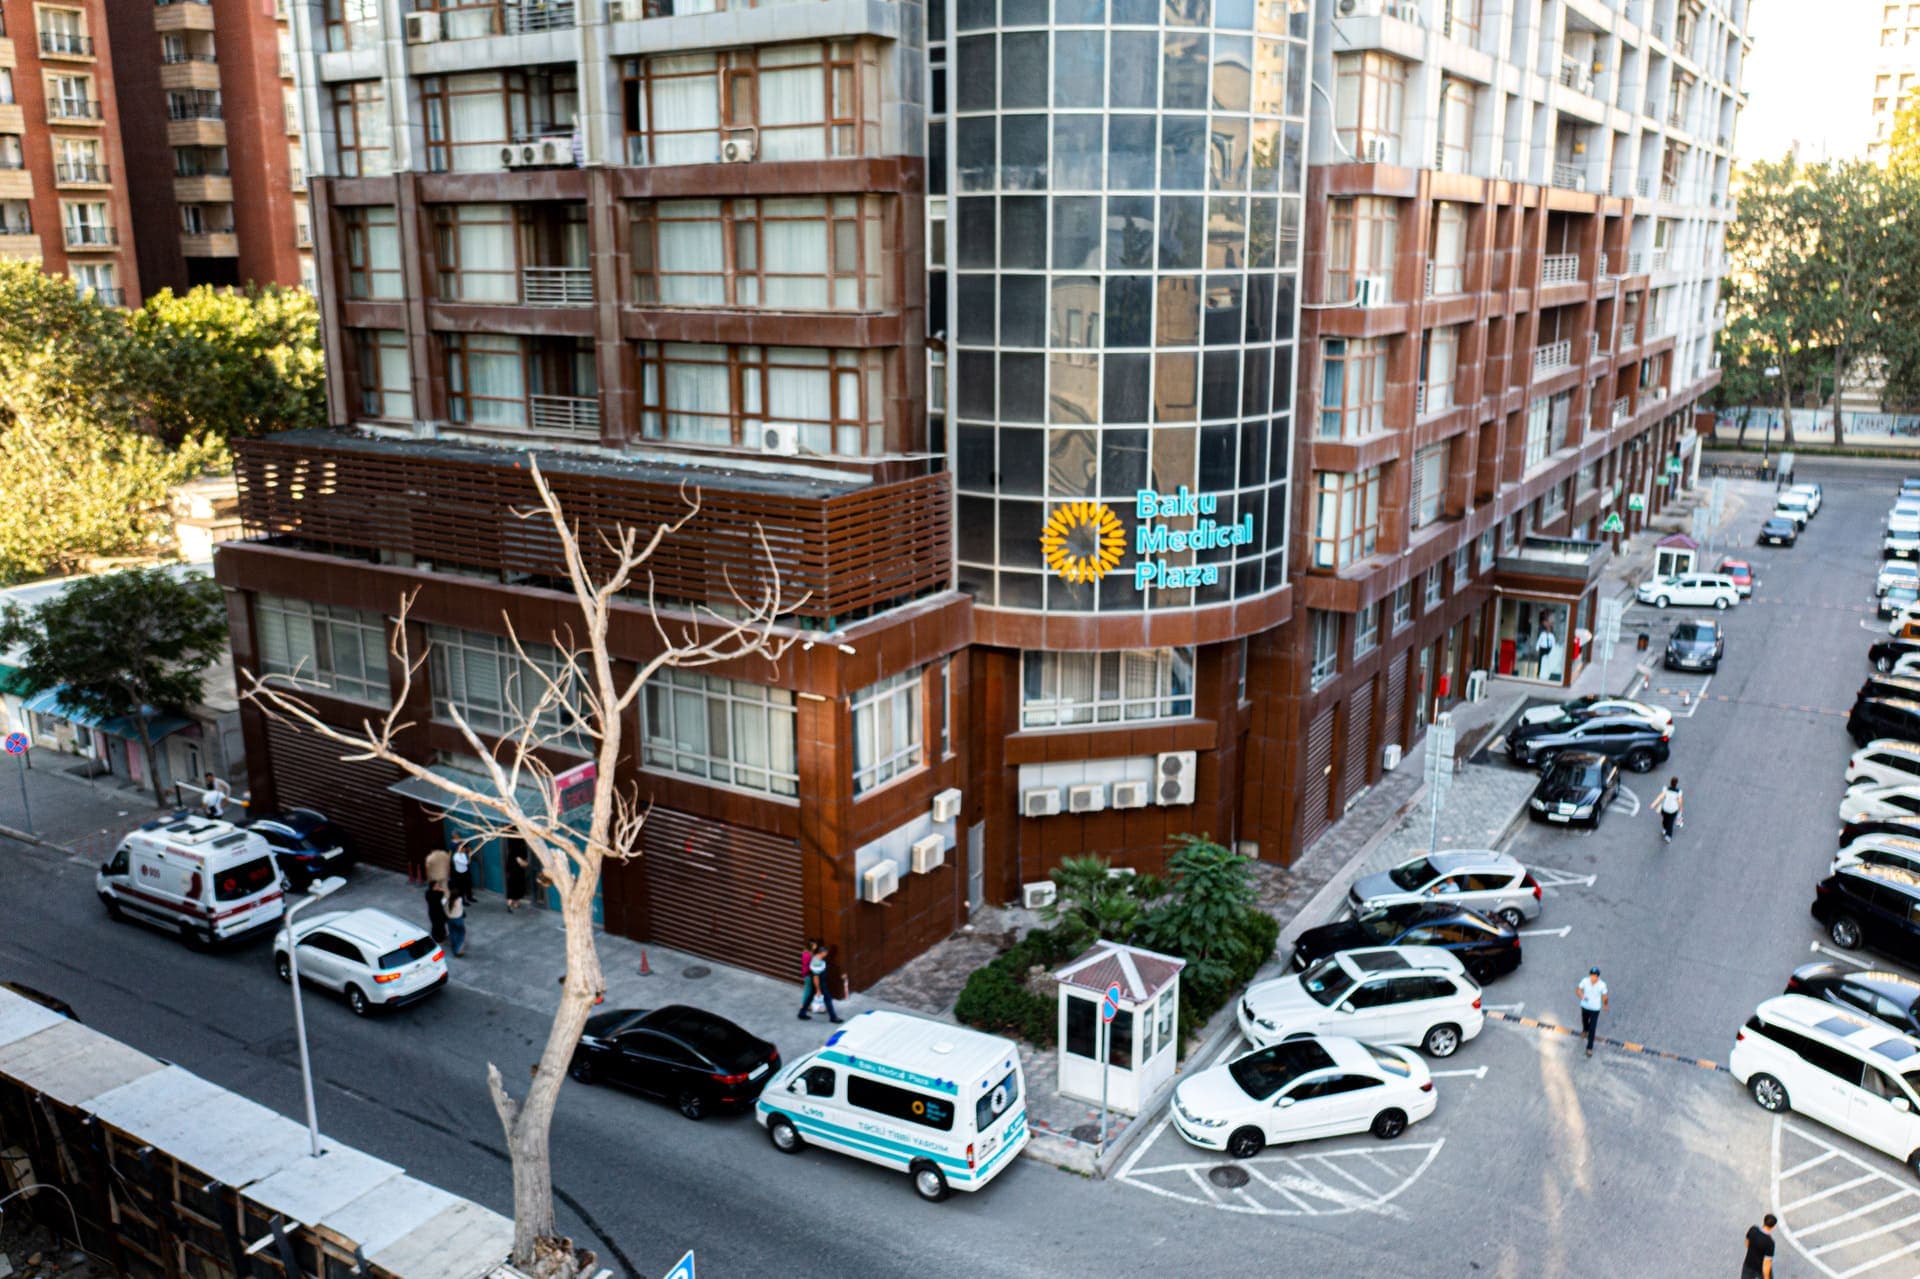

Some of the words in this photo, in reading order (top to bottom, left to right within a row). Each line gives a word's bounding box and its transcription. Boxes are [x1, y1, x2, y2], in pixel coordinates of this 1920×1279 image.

[1136, 485, 1217, 518] Baku
[1136, 513, 1253, 554] Medical
[1135, 559, 1218, 590] Plaza
